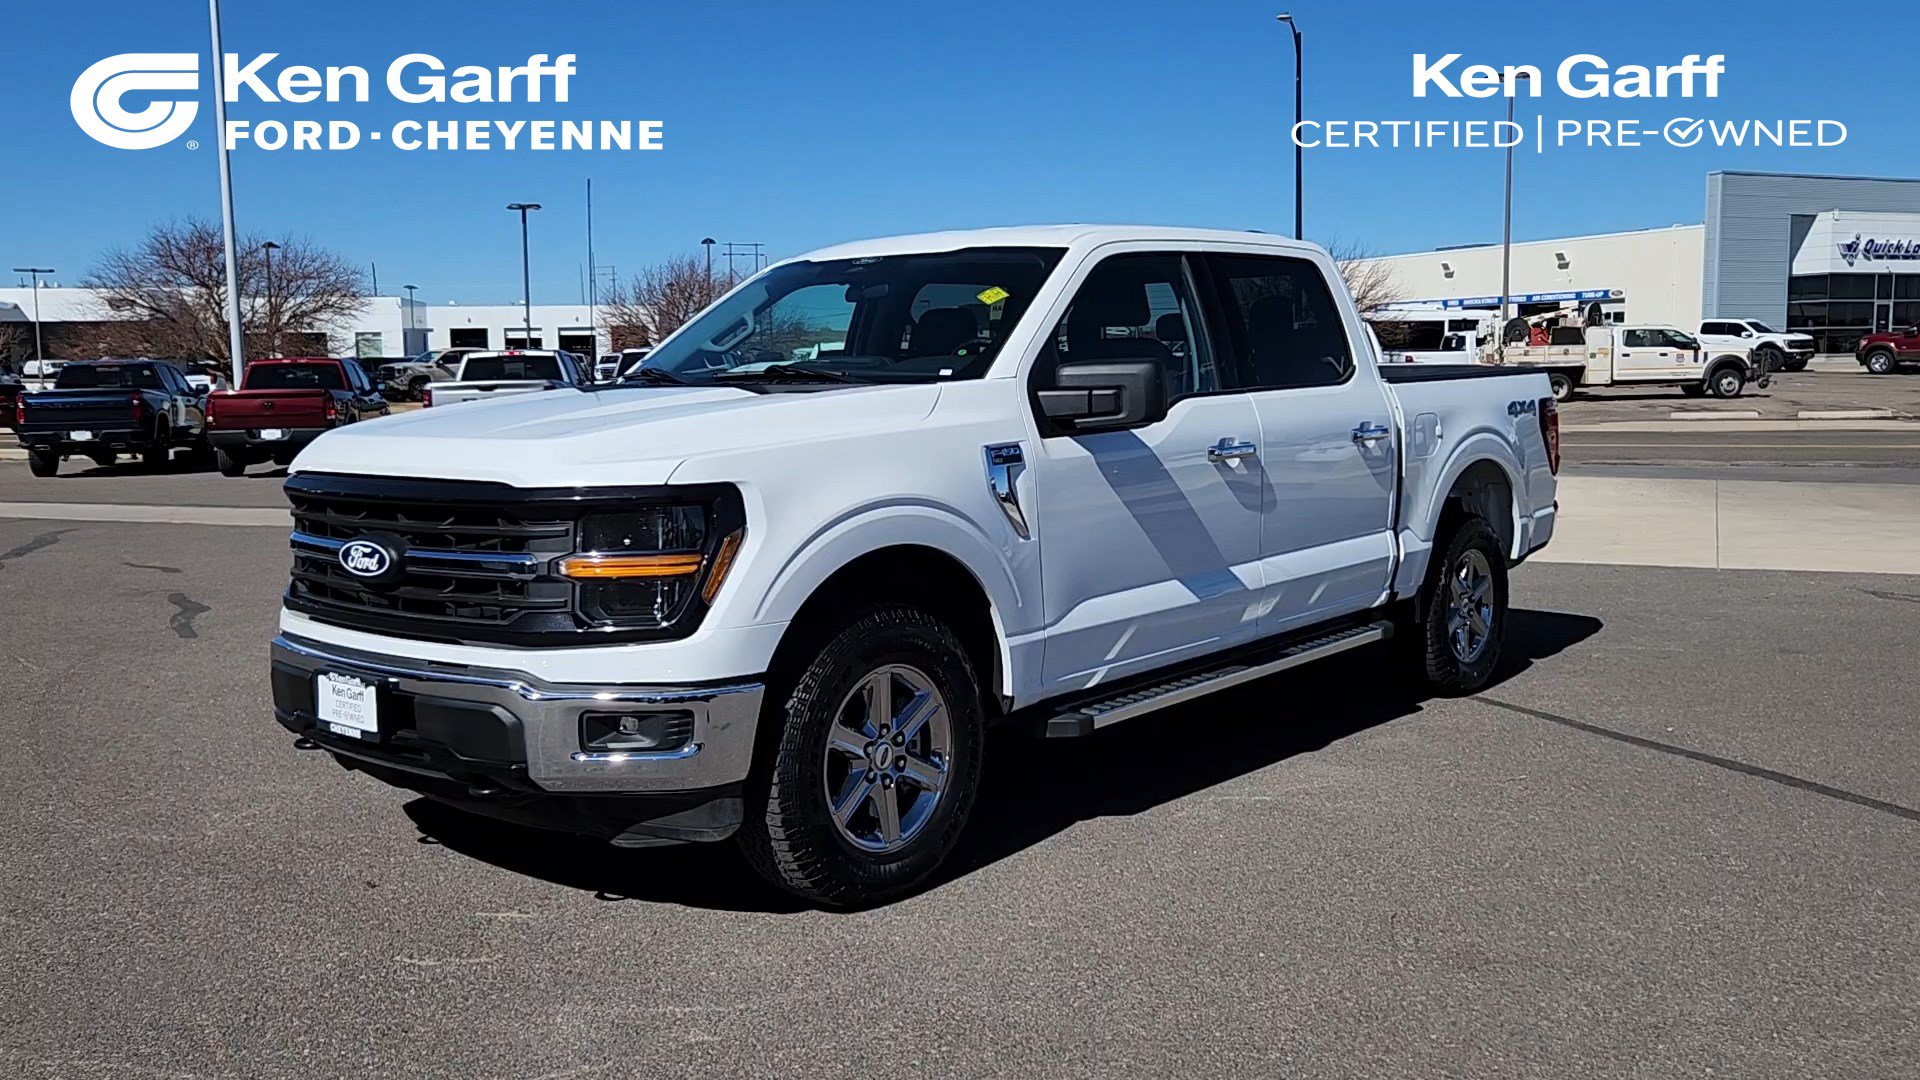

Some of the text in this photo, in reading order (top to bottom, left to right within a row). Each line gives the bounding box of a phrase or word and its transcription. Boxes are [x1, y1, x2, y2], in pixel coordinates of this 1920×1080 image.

[1863, 238, 1905, 256] Quick
[348, 545, 380, 571] Ford
[331, 684, 365, 703] Ken Garff
[335, 699, 362, 713] CERTIFIED
